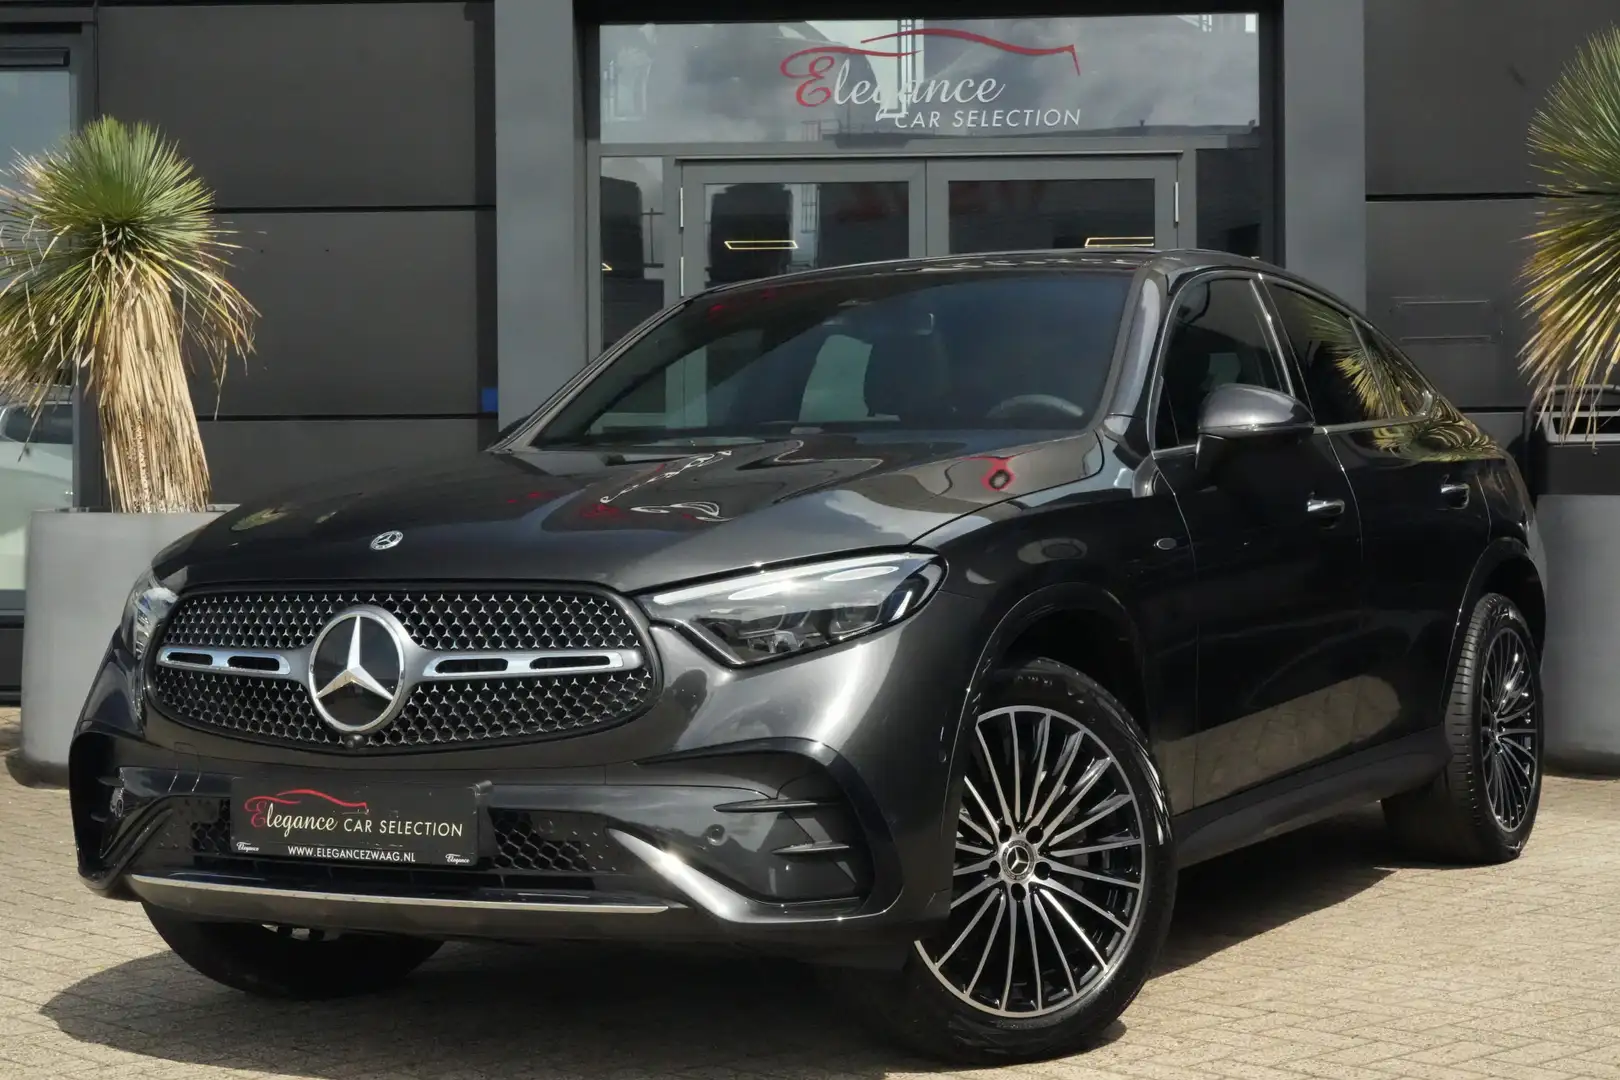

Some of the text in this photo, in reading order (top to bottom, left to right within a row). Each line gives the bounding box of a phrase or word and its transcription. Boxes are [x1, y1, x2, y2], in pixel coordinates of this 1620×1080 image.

[895, 109, 1081, 128] CAR SELECTION
[244, 796, 463, 837] Elegance CAR SELECTION
[287, 845, 416, 863] WWW.ELEGANCEZWAAG.NL
